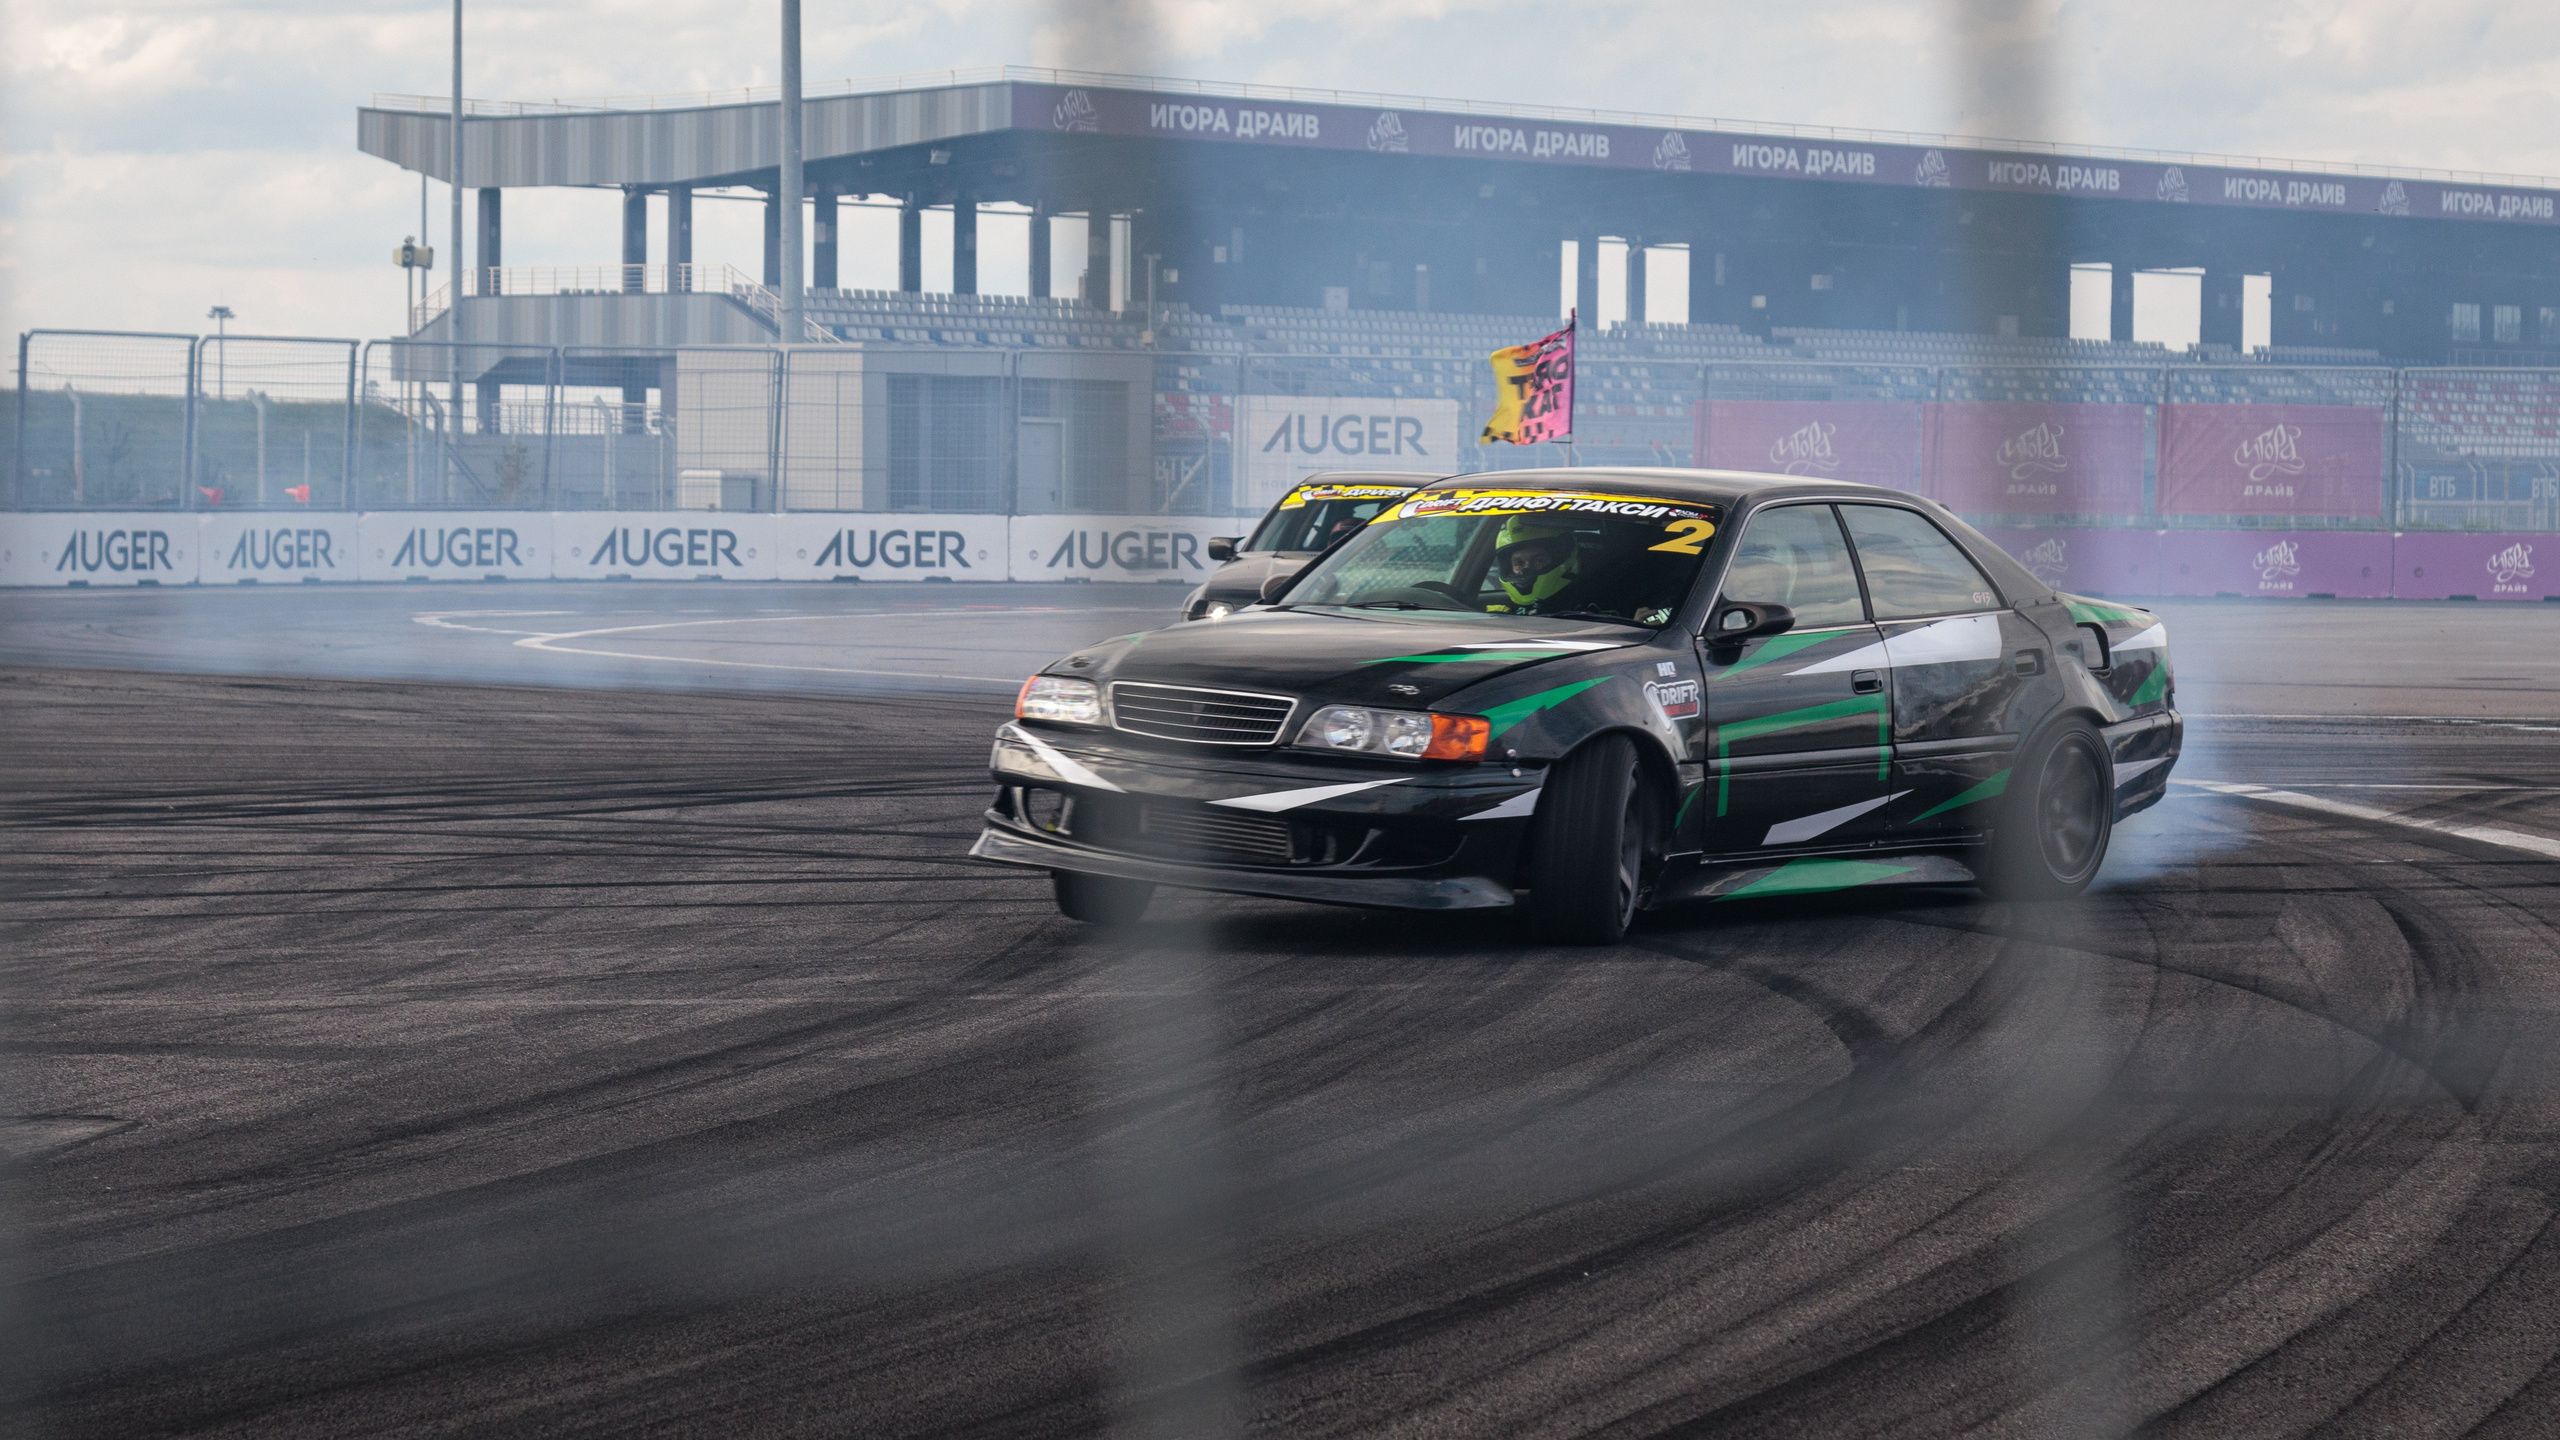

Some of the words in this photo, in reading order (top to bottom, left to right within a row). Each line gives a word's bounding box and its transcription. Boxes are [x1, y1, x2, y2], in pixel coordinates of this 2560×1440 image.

[1151, 103, 1230, 133] ИГОРА
[1454, 125, 1528, 152] ИГОРА
[1733, 144, 1800, 170] ИГОРА
[1988, 161, 2051, 186] ИГОРА
[2225, 177, 2282, 200] ИГОРА
[2442, 191, 2495, 214] ИГОРА
[1262, 411, 1429, 456] AUGER
[2006, 482, 2057, 495] ДРАЙВ
[2243, 483, 2294, 497] ДРАЙВ
[2430, 475, 2456, 498] ВТБ
[56, 529, 173, 572] AUGER
[227, 528, 335, 569] AUGER
[391, 527, 523, 568] AUGER
[588, 526, 743, 566] AUGER
[814, 527, 972, 568] AUGER
[1046, 529, 1205, 570] AUGER
[1648, 518, 1715, 555] 2
[1660, 684, 1695, 706] DRIFT
